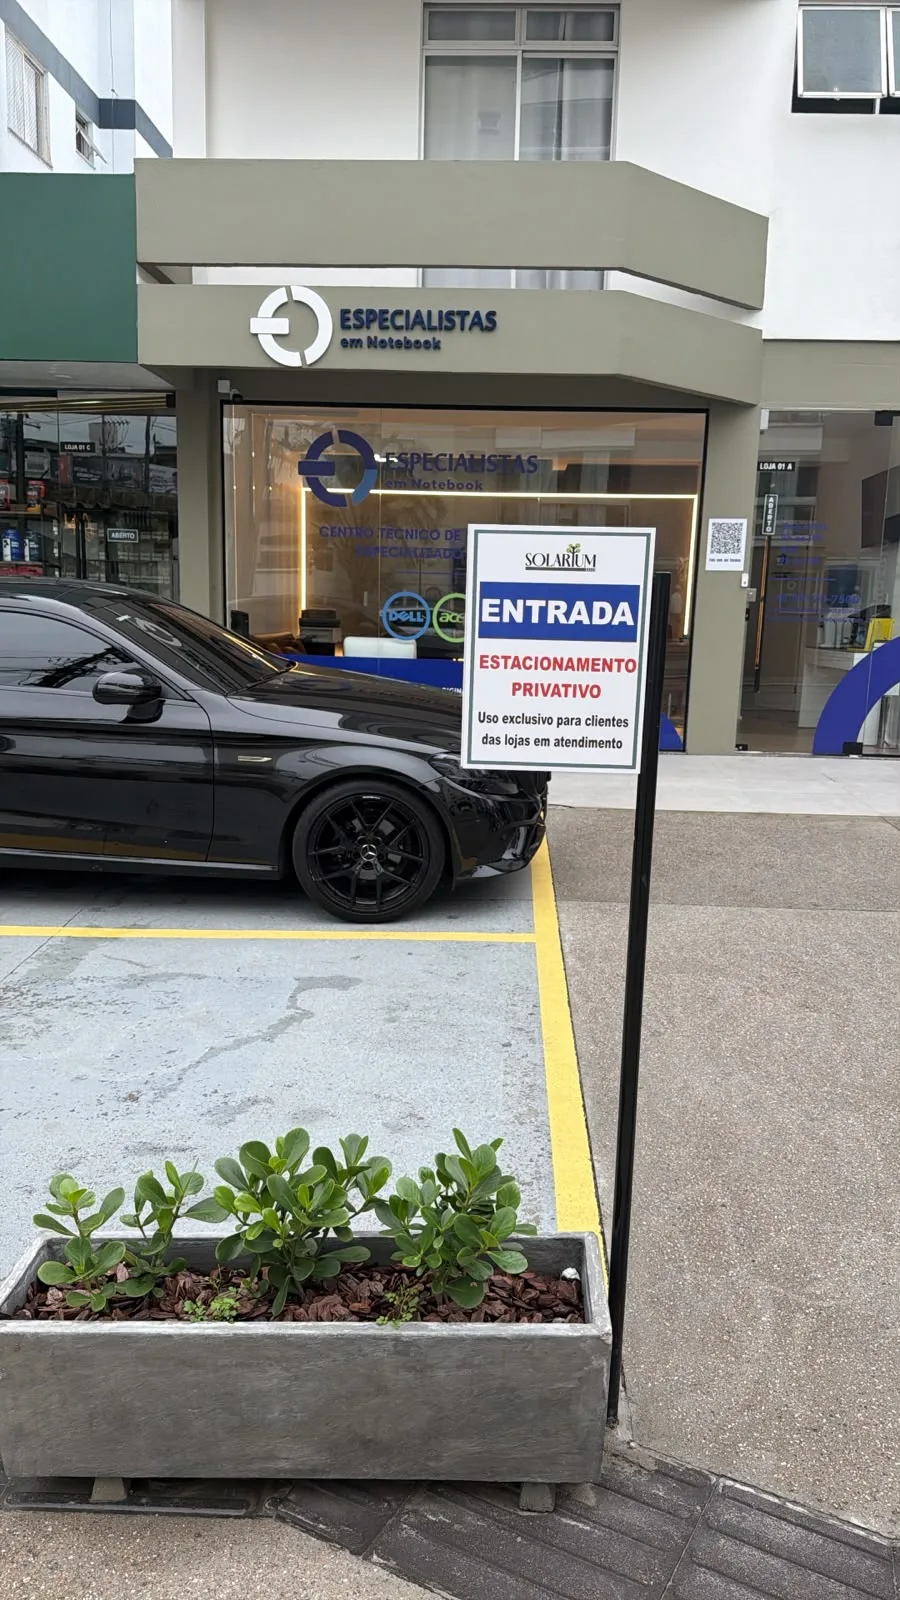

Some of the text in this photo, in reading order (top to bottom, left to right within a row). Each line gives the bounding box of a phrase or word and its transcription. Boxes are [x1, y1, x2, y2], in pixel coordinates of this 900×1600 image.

[340, 308, 497, 332] ESPECIALISTAS
[340, 336, 441, 351] em Notebook
[385, 452, 539, 474] ESPECIALISTAS
[760, 462, 776, 470] LOJA
[385, 478, 484, 491] em Notebook
[765, 496, 774, 533] ABERTO
[110, 531, 135, 540] ABERTO
[319, 525, 375, 539] CENTRO
[444, 527, 462, 541] DE
[525, 551, 596, 568] SOLARIUM
[390, 610, 424, 623] DELL
[440, 612, 465, 623] ace
[482, 598, 635, 626] ENTRADA
[479, 654, 638, 673] ESTACIONAMENTO
[511, 682, 602, 699] PRIVATIVO
[478, 711, 629, 728] Uso exclusivo para clientes
[482, 733, 623, 750] das lojas em atendimento
